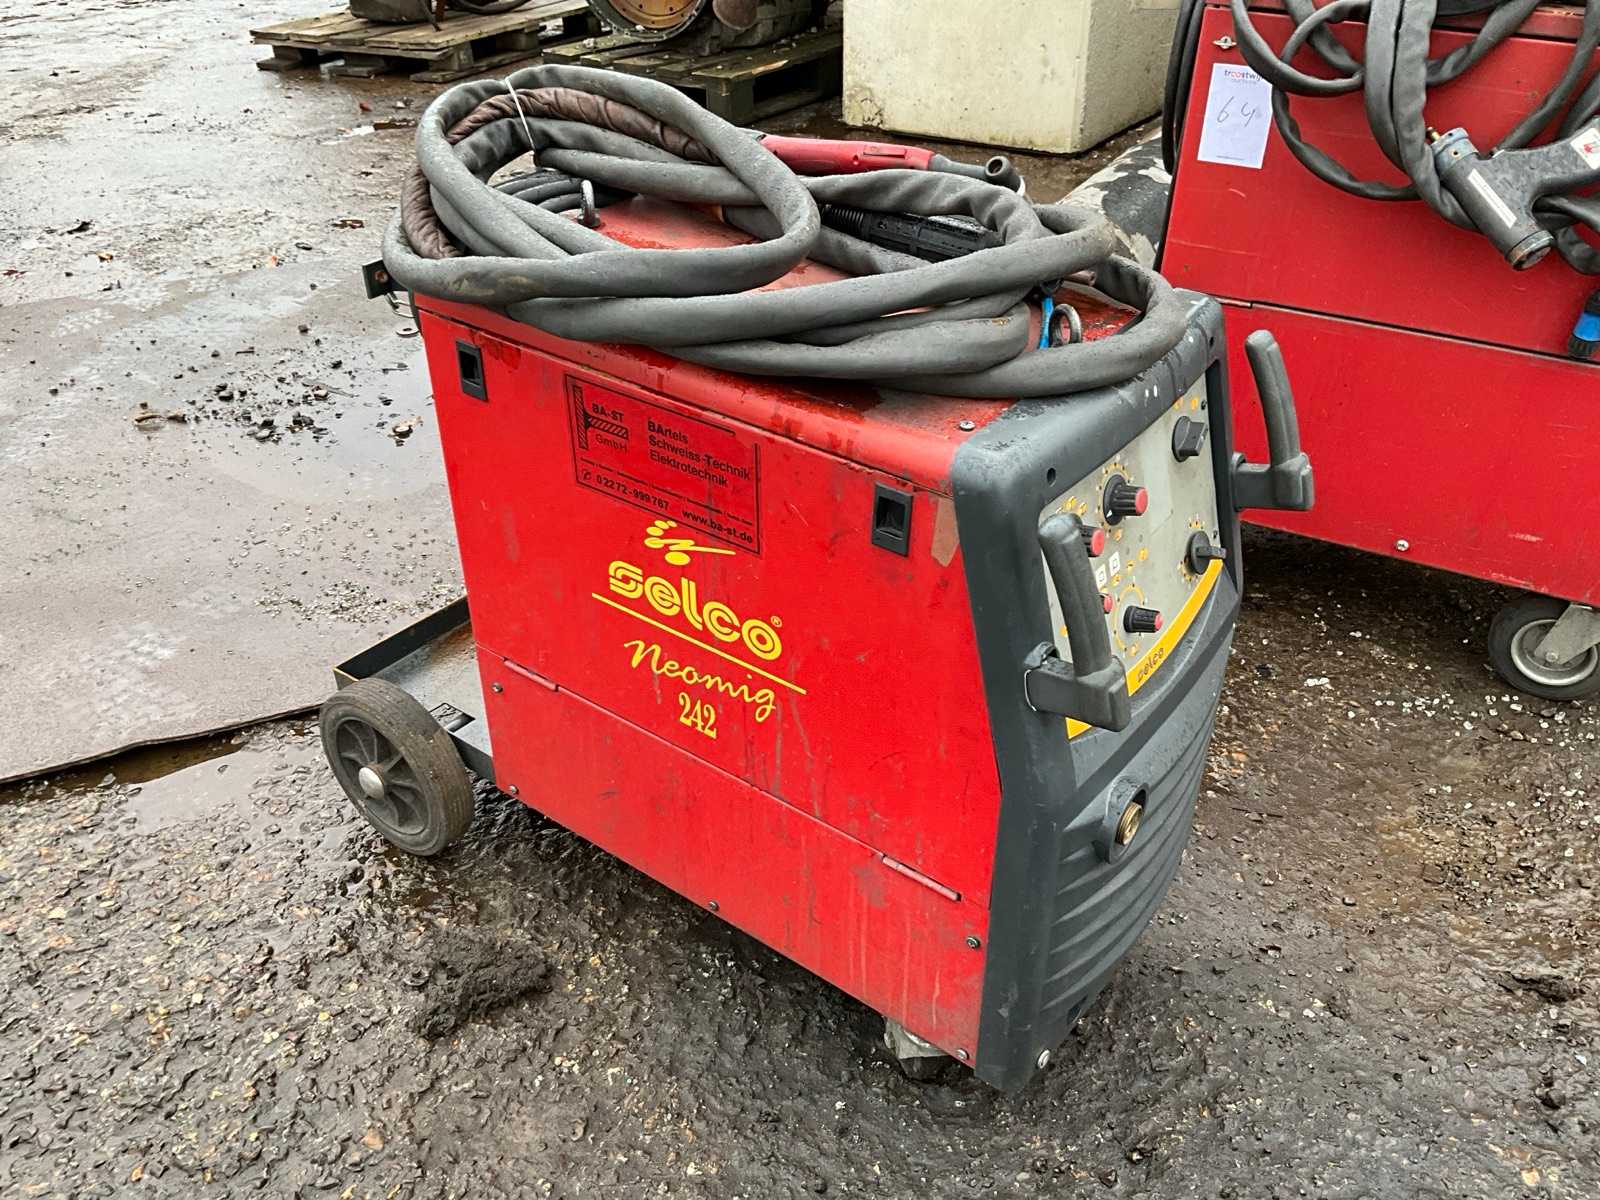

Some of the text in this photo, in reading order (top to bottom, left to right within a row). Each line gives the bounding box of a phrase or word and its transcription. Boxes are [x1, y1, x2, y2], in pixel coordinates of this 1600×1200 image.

[1217, 96, 1256, 127] 64
[592, 403, 625, 421] BA-ST
[596, 434, 628, 452] GmbH
[648, 420, 688, 443] BArtels
[650, 449, 728, 486] Elektrotechnik
[682, 510, 753, 542] www.ba-st.de
[623, 640, 776, 722] Neomig
[678, 692, 717, 739] 242
